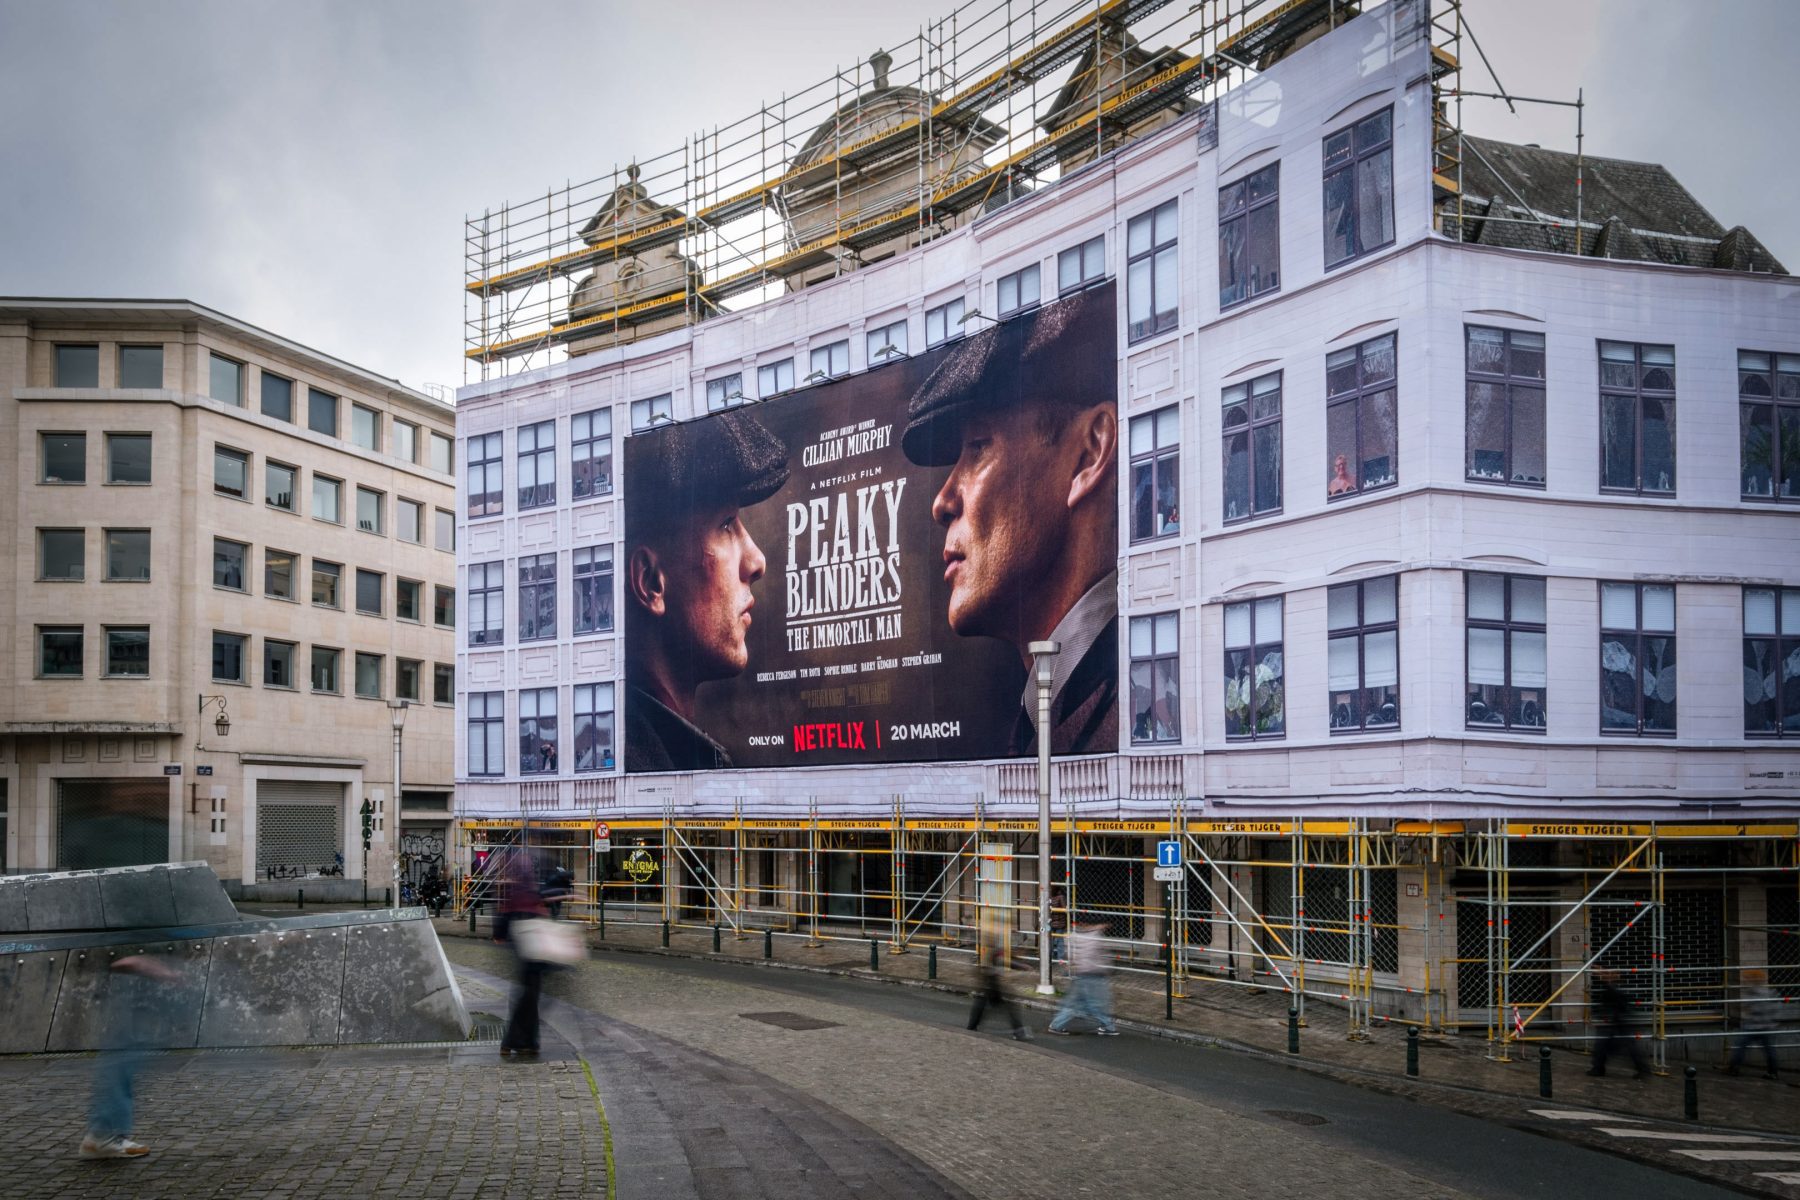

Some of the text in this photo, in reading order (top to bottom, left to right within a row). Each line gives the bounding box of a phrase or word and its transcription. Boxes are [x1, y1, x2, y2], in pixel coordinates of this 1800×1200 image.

[1118, 65, 1179, 103] STEIGER TIJGER
[819, 429, 839, 441] ACADEMY
[858, 419, 876, 431] WINNER
[802, 424, 893, 468] CILLIAN MURPHY
[810, 466, 882, 491] A NETFLIX FILM
[786, 477, 907, 571] PEAKY
[785, 552, 902, 618] BLINDERS
[786, 613, 902, 652] THE IMMORTAL MAN
[800, 668, 809, 678] TIM
[824, 665, 840, 676] SOPHIE
[861, 661, 876, 672] BARRY
[902, 656, 922, 667] STEPHEN
[923, 653, 942, 665] GRAHAM
[749, 721, 961, 753] ONLY ON NETFLIX 20 MARCH
[1127, 822, 1155, 830] TIJGER
[1250, 823, 1281, 832] TIJGER
[1532, 825, 1623, 835] STEIGER TIJGER
[622, 860, 660, 871] ENYGMA
